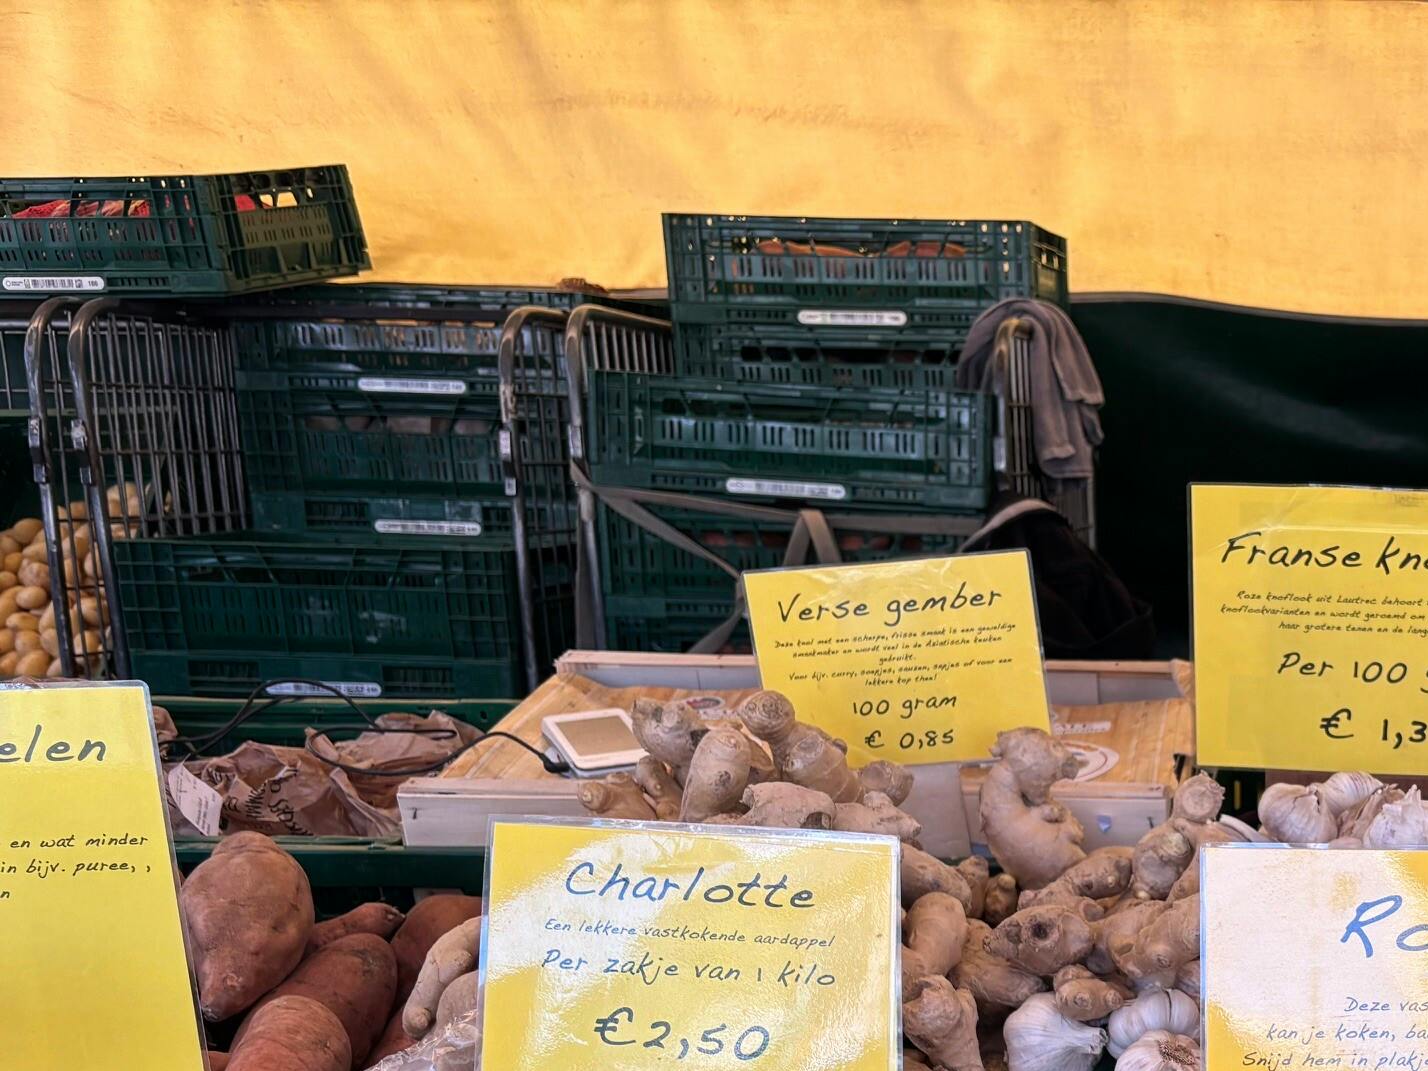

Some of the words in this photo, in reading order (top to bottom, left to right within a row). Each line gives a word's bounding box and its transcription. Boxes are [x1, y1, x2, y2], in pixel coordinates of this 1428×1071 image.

[1221, 531, 1363, 569] Franse
[778, 592, 870, 623] Verse
[884, 581, 1002, 627] gember
[1277, 651, 1333, 677] Per
[1353, 660, 1408, 684] 100
[853, 700, 890, 716] 100
[900, 695, 957, 719] gram
[1319, 708, 1355, 740] €
[864, 730, 886, 749] €
[900, 728, 954, 750] 0,85
[10, 838, 31, 849] en
[40, 834, 75, 848] wat
[85, 833, 149, 848] minder
[26, 858, 65, 879] bijv.
[73, 860, 136, 878] puree,
[565, 861, 815, 910] Charlotte
[544, 918, 571, 932] Een
[578, 919, 637, 937] lekkere
[644, 925, 746, 943] vastkokende
[754, 934, 835, 949] aardappel
[541, 949, 589, 972] Per
[603, 952, 679, 985] zakje
[694, 963, 740, 982] van
[777, 961, 835, 987] kilo
[1343, 996, 1391, 1013] Deze
[1266, 1023, 1297, 1040] kan
[1302, 1026, 1325, 1045] je
[1335, 1023, 1395, 1042] koken,
[1242, 1051, 1293, 1071] Snijd
[1302, 1052, 1342, 1067] hem
[1351, 1054, 1368, 1066] in
